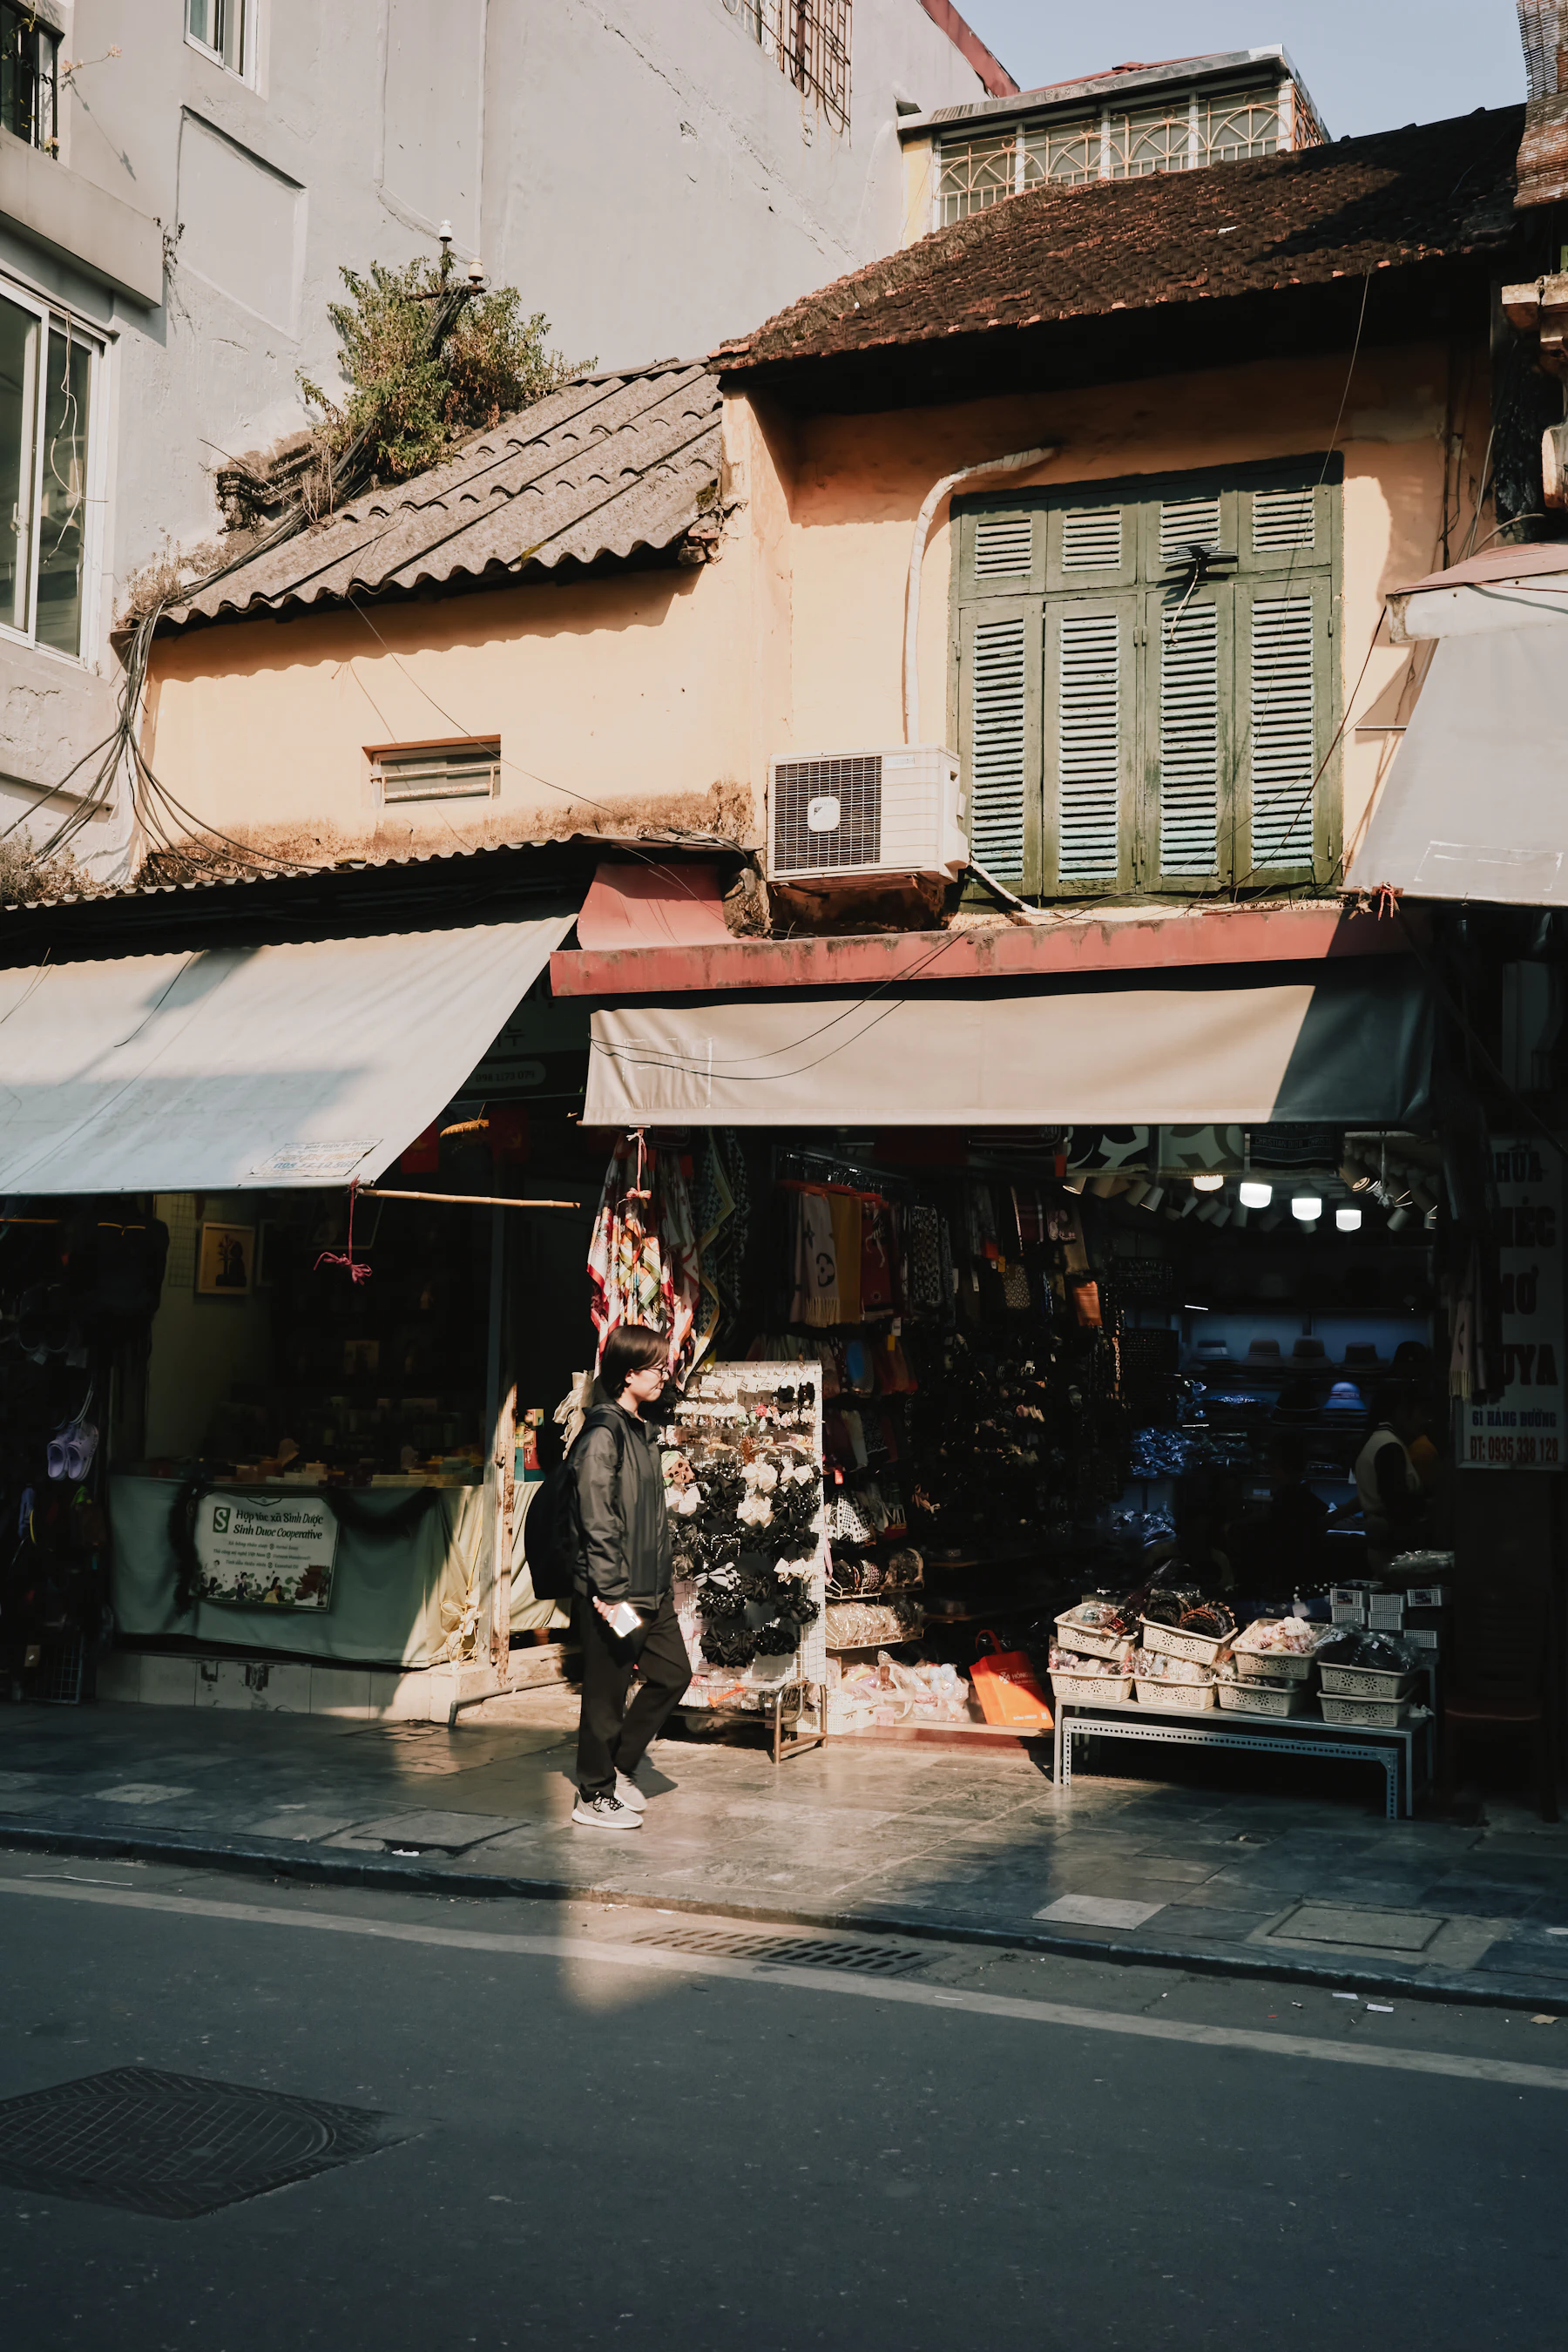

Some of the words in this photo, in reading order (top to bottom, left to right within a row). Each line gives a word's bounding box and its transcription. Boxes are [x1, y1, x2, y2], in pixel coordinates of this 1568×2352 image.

[1254, 1137, 1287, 1148] CHRISTIAN
[1472, 1410, 1484, 1427] 61
[1488, 1436, 1514, 1462] 0935
[1517, 1436, 1537, 1462] 338
[1539, 1436, 1559, 1462] 128
[215, 1509, 227, 1531] S
[236, 1509, 254, 1524] Hợp
[255, 1511, 269, 1523] tác
[270, 1512, 282, 1523] xã
[283, 1512, 302, 1524] Sinh
[302, 1513, 324, 1527] Dược
[233, 1524, 254, 1536] Sinh
[255, 1525, 276, 1537] Duoc
[277, 1527, 323, 1542] Cooperative
